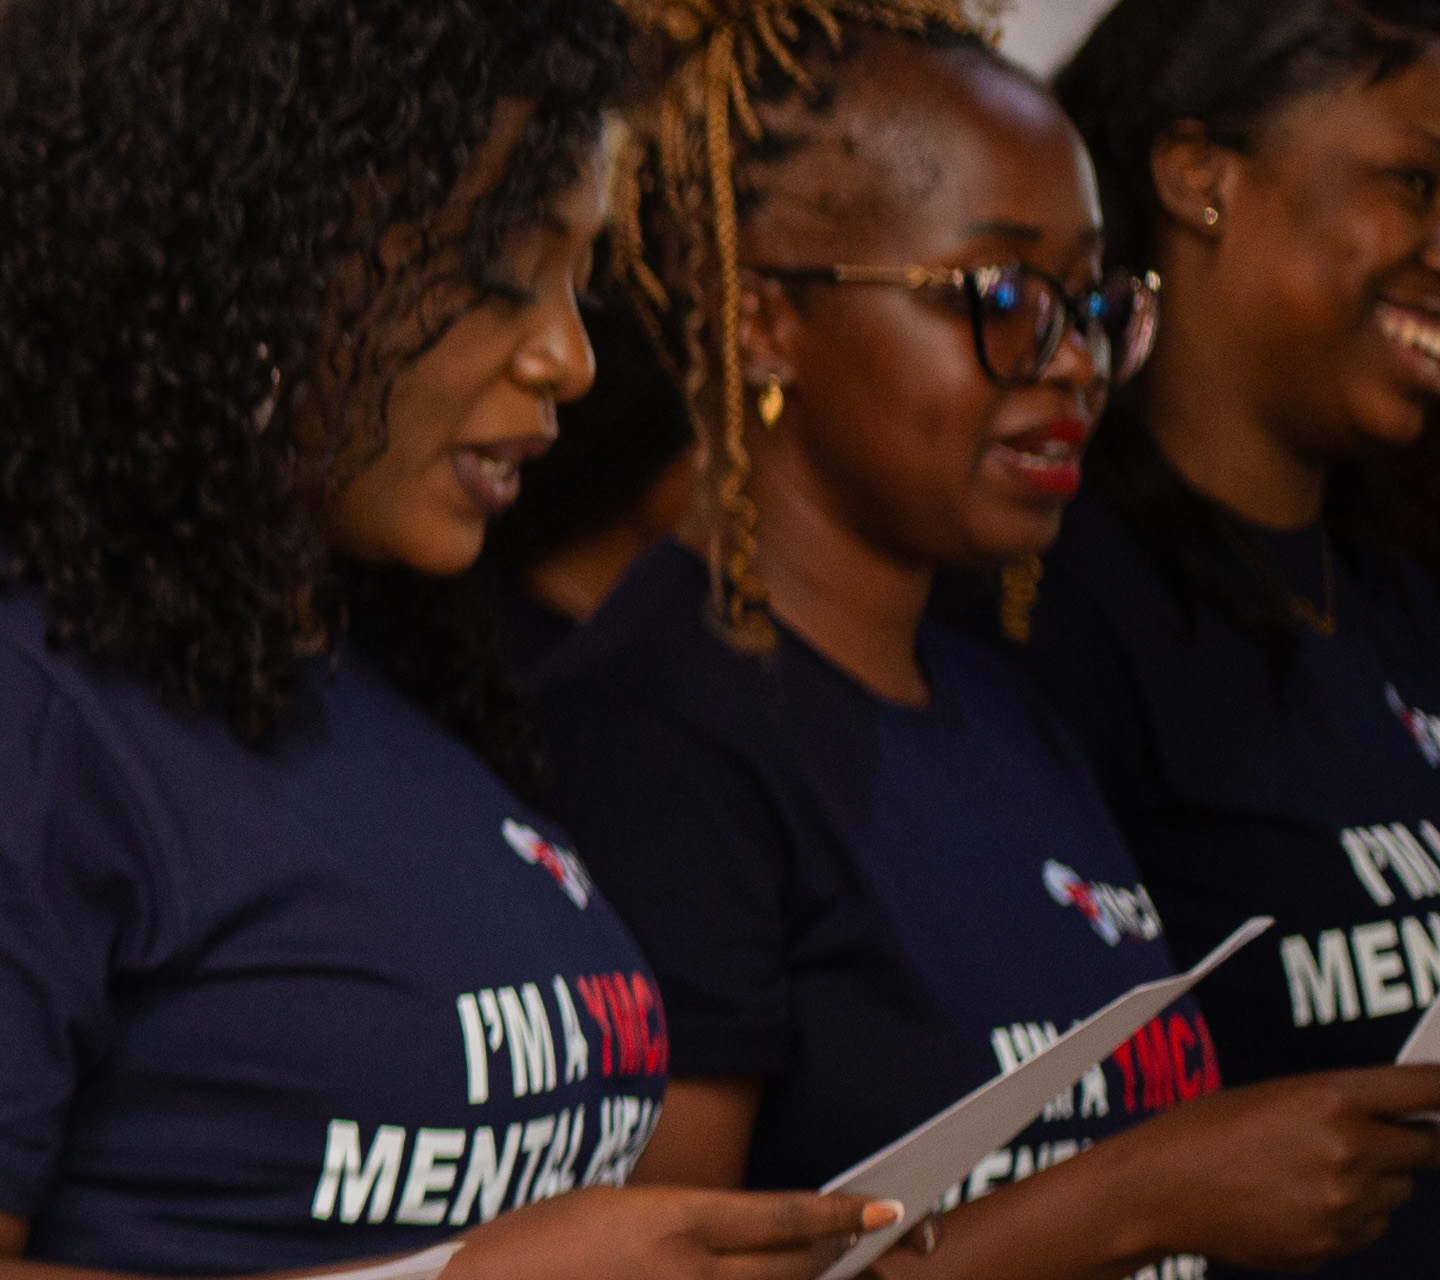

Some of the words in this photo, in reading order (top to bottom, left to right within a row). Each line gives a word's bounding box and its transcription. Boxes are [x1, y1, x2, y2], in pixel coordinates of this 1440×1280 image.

[1280, 911, 1440, 1029] MEN
[457, 981, 557, 1105] I'M
[553, 973, 589, 1086] A
[312, 1104, 586, 1225] MENTAL
